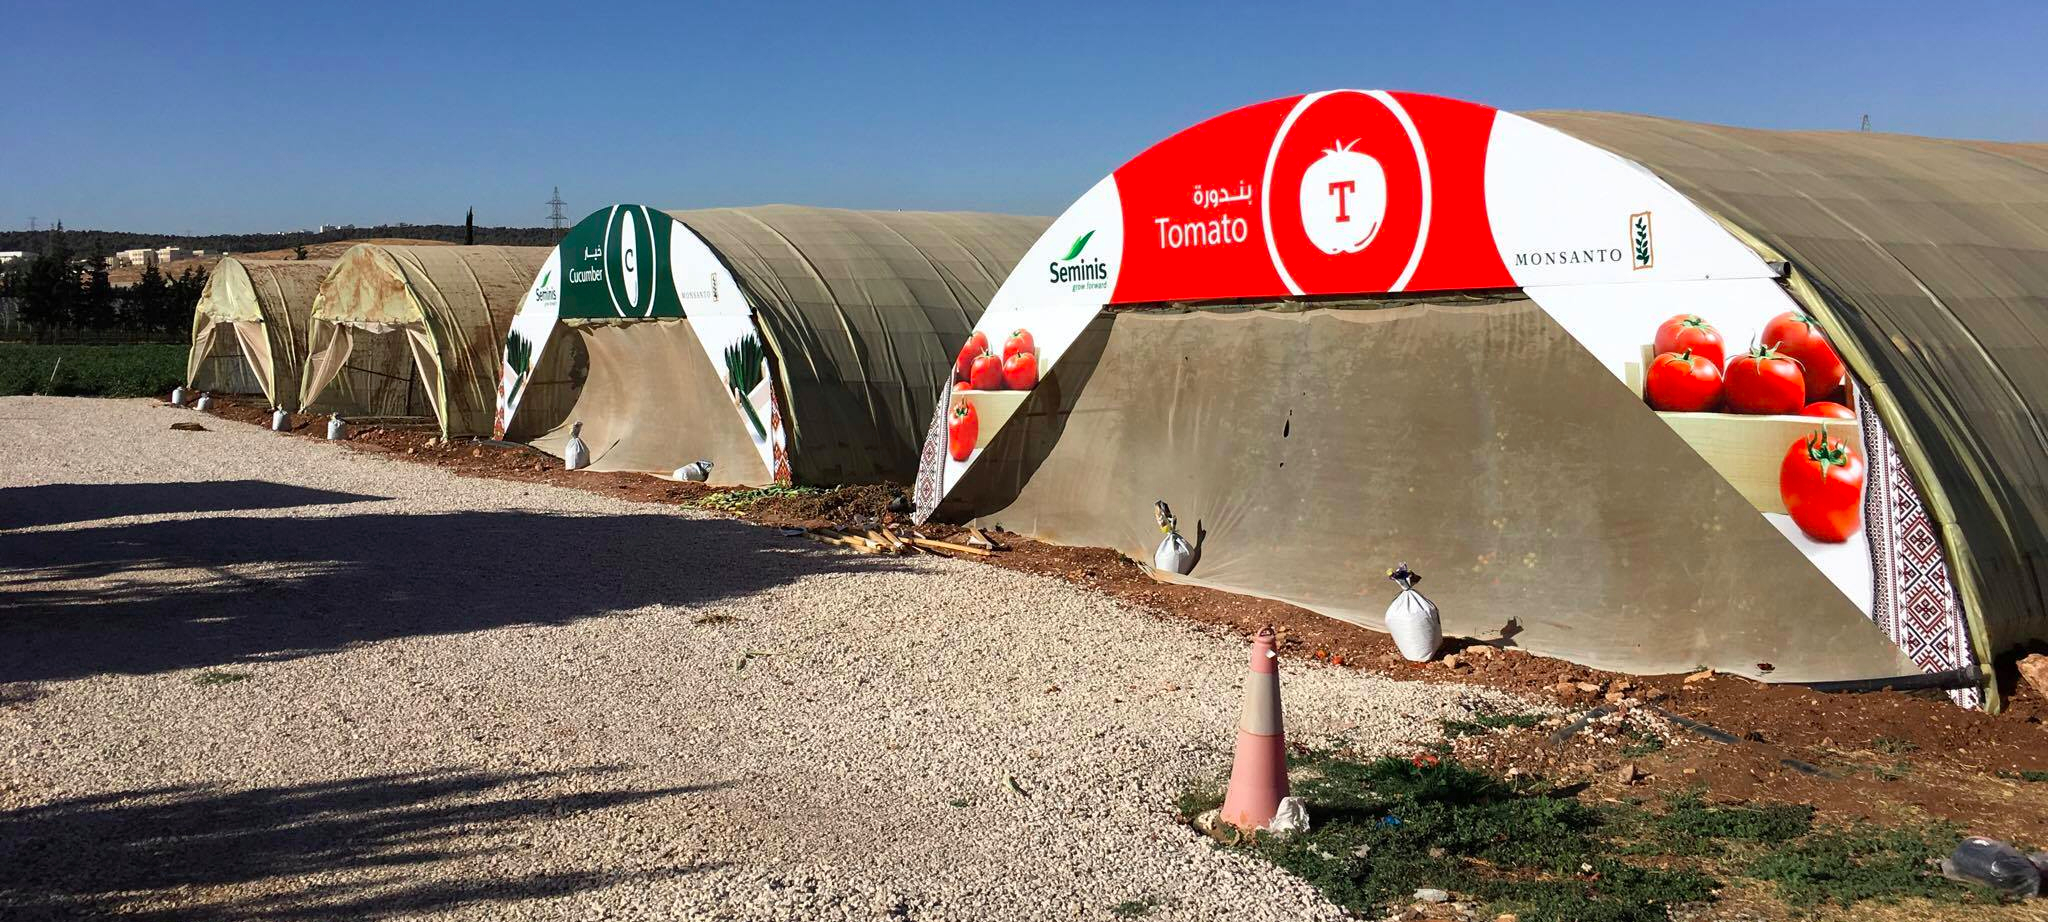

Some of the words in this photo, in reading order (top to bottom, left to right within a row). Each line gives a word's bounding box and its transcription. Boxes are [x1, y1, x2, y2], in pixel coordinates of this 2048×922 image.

[1328, 180, 1355, 223] T
[1155, 213, 1248, 250] Tomato
[625, 248, 635, 273] C
[1515, 248, 1623, 266] MONSANTO
[569, 267, 603, 284] Cucumber
[1050, 257, 1107, 284] Seminis
